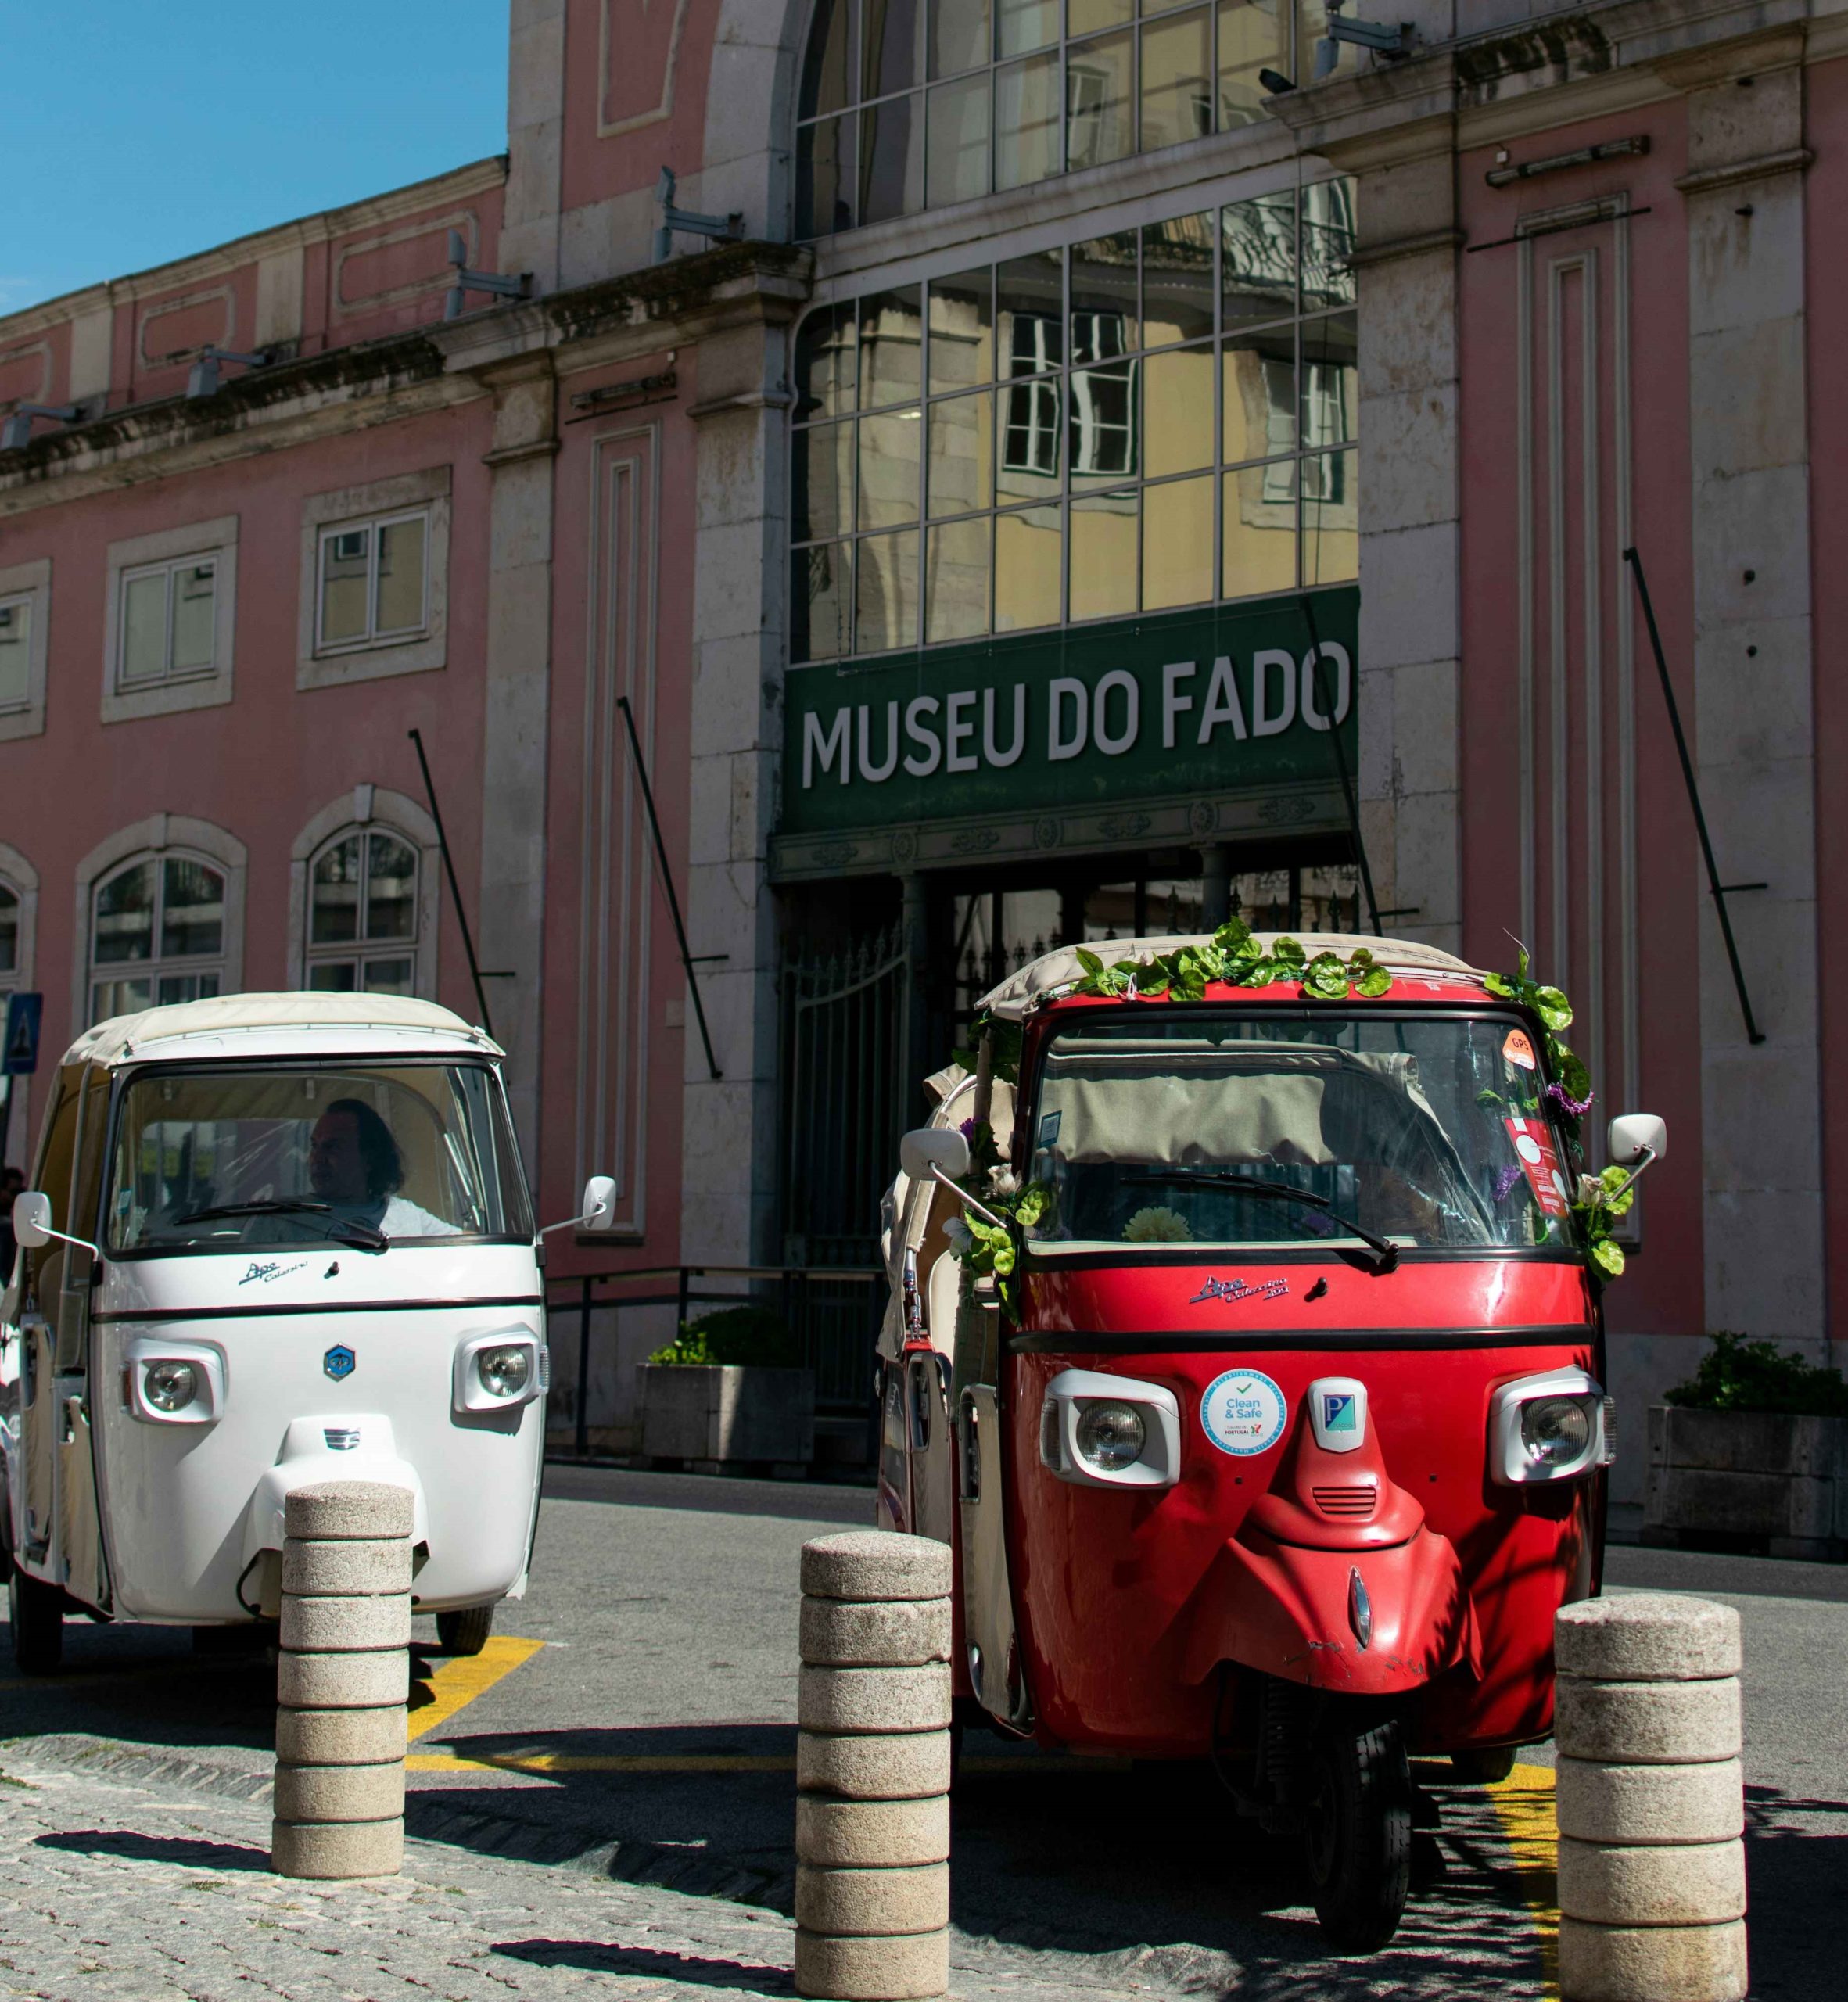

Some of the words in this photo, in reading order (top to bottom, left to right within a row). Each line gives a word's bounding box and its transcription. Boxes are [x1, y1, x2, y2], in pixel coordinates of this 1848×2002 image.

[802, 683, 1025, 789] MUSEU
[1048, 669, 1139, 761] DO
[1162, 640, 1350, 748] FADO
[1512, 1038, 1529, 1050] GPS
[239, 1262, 280, 1285] Ape
[1189, 1275, 1247, 1304] Ape
[1225, 1408, 1233, 1419] &
[1236, 1408, 1262, 1419] Safe
[1226, 1398, 1260, 1408] Clean
[1326, 1397, 1343, 1421] P
